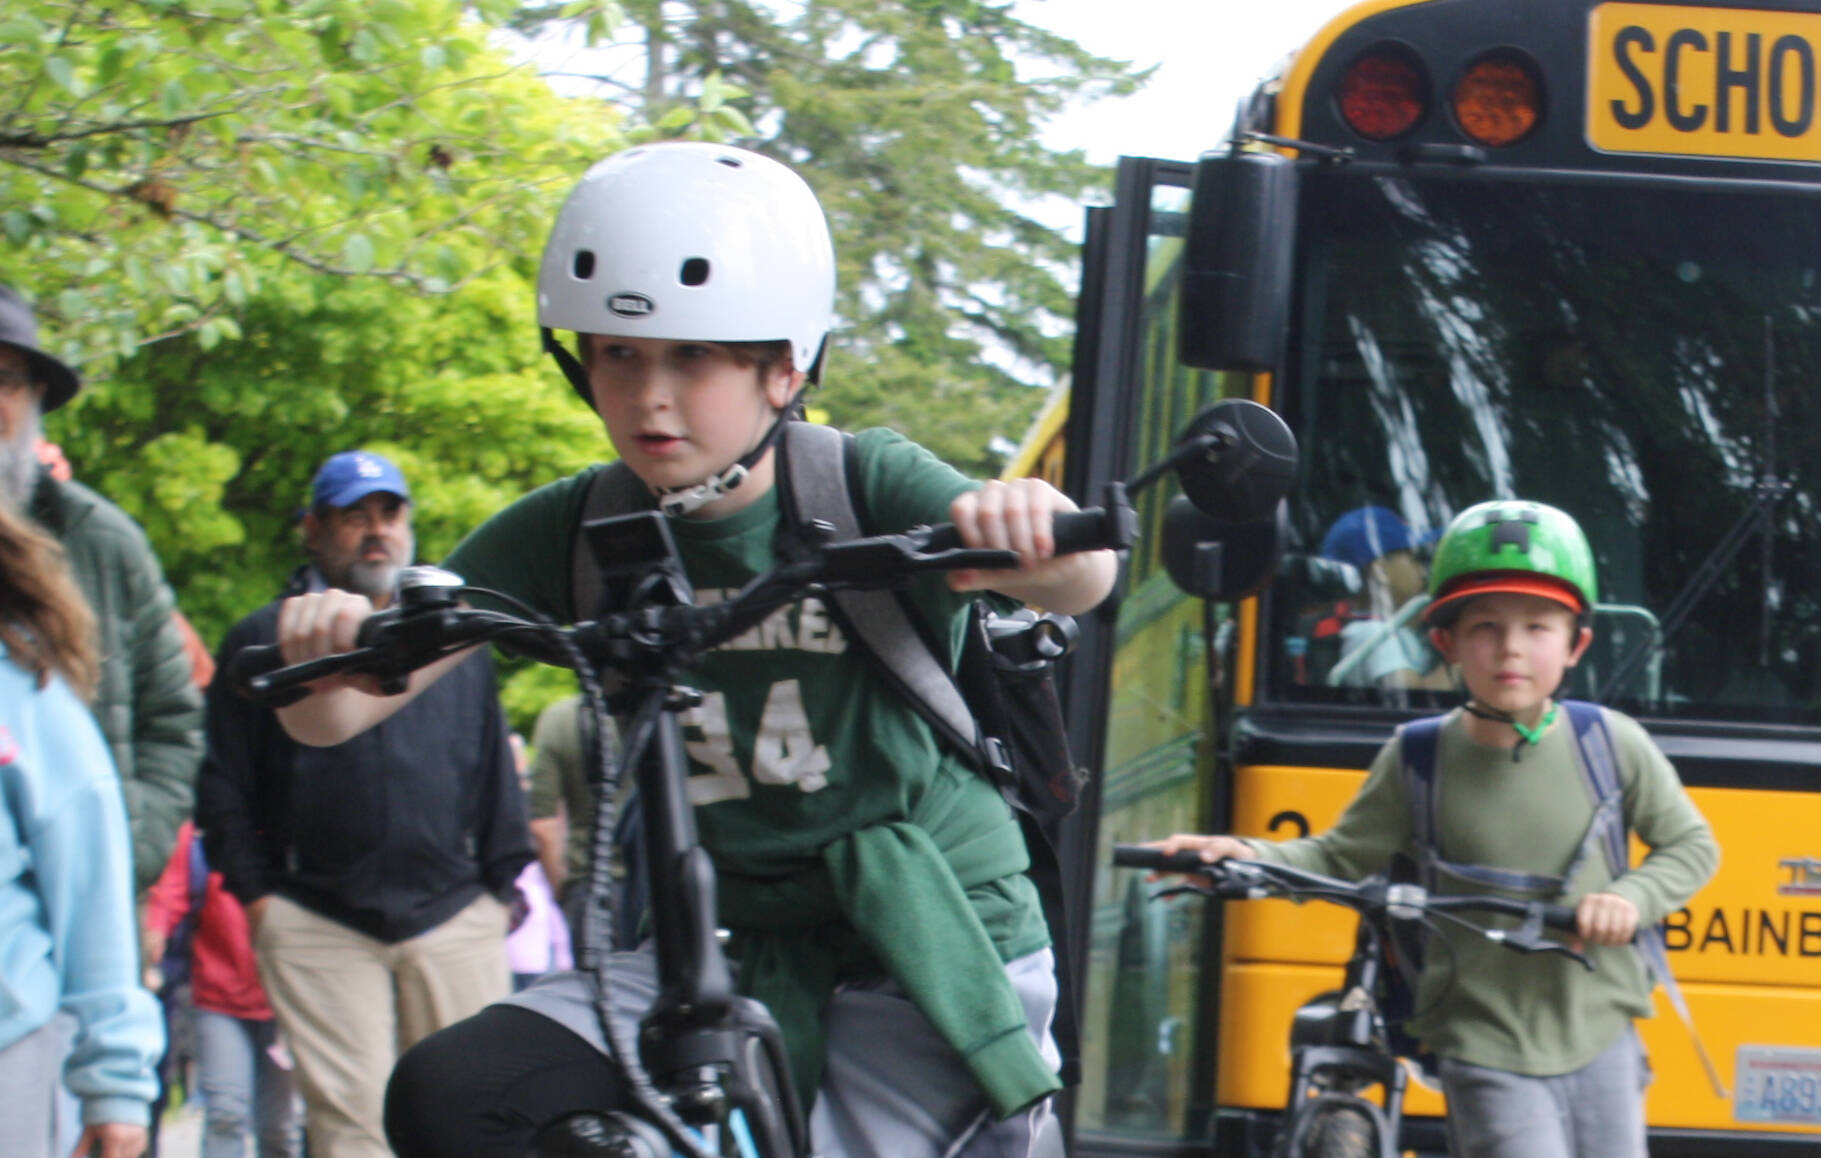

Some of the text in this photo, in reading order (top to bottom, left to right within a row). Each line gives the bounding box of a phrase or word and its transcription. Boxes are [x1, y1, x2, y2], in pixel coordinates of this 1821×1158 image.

[1610, 25, 1816, 138] SCHO
[1662, 907, 1821, 957] BAINB
[1760, 1075, 1821, 1112] A89
